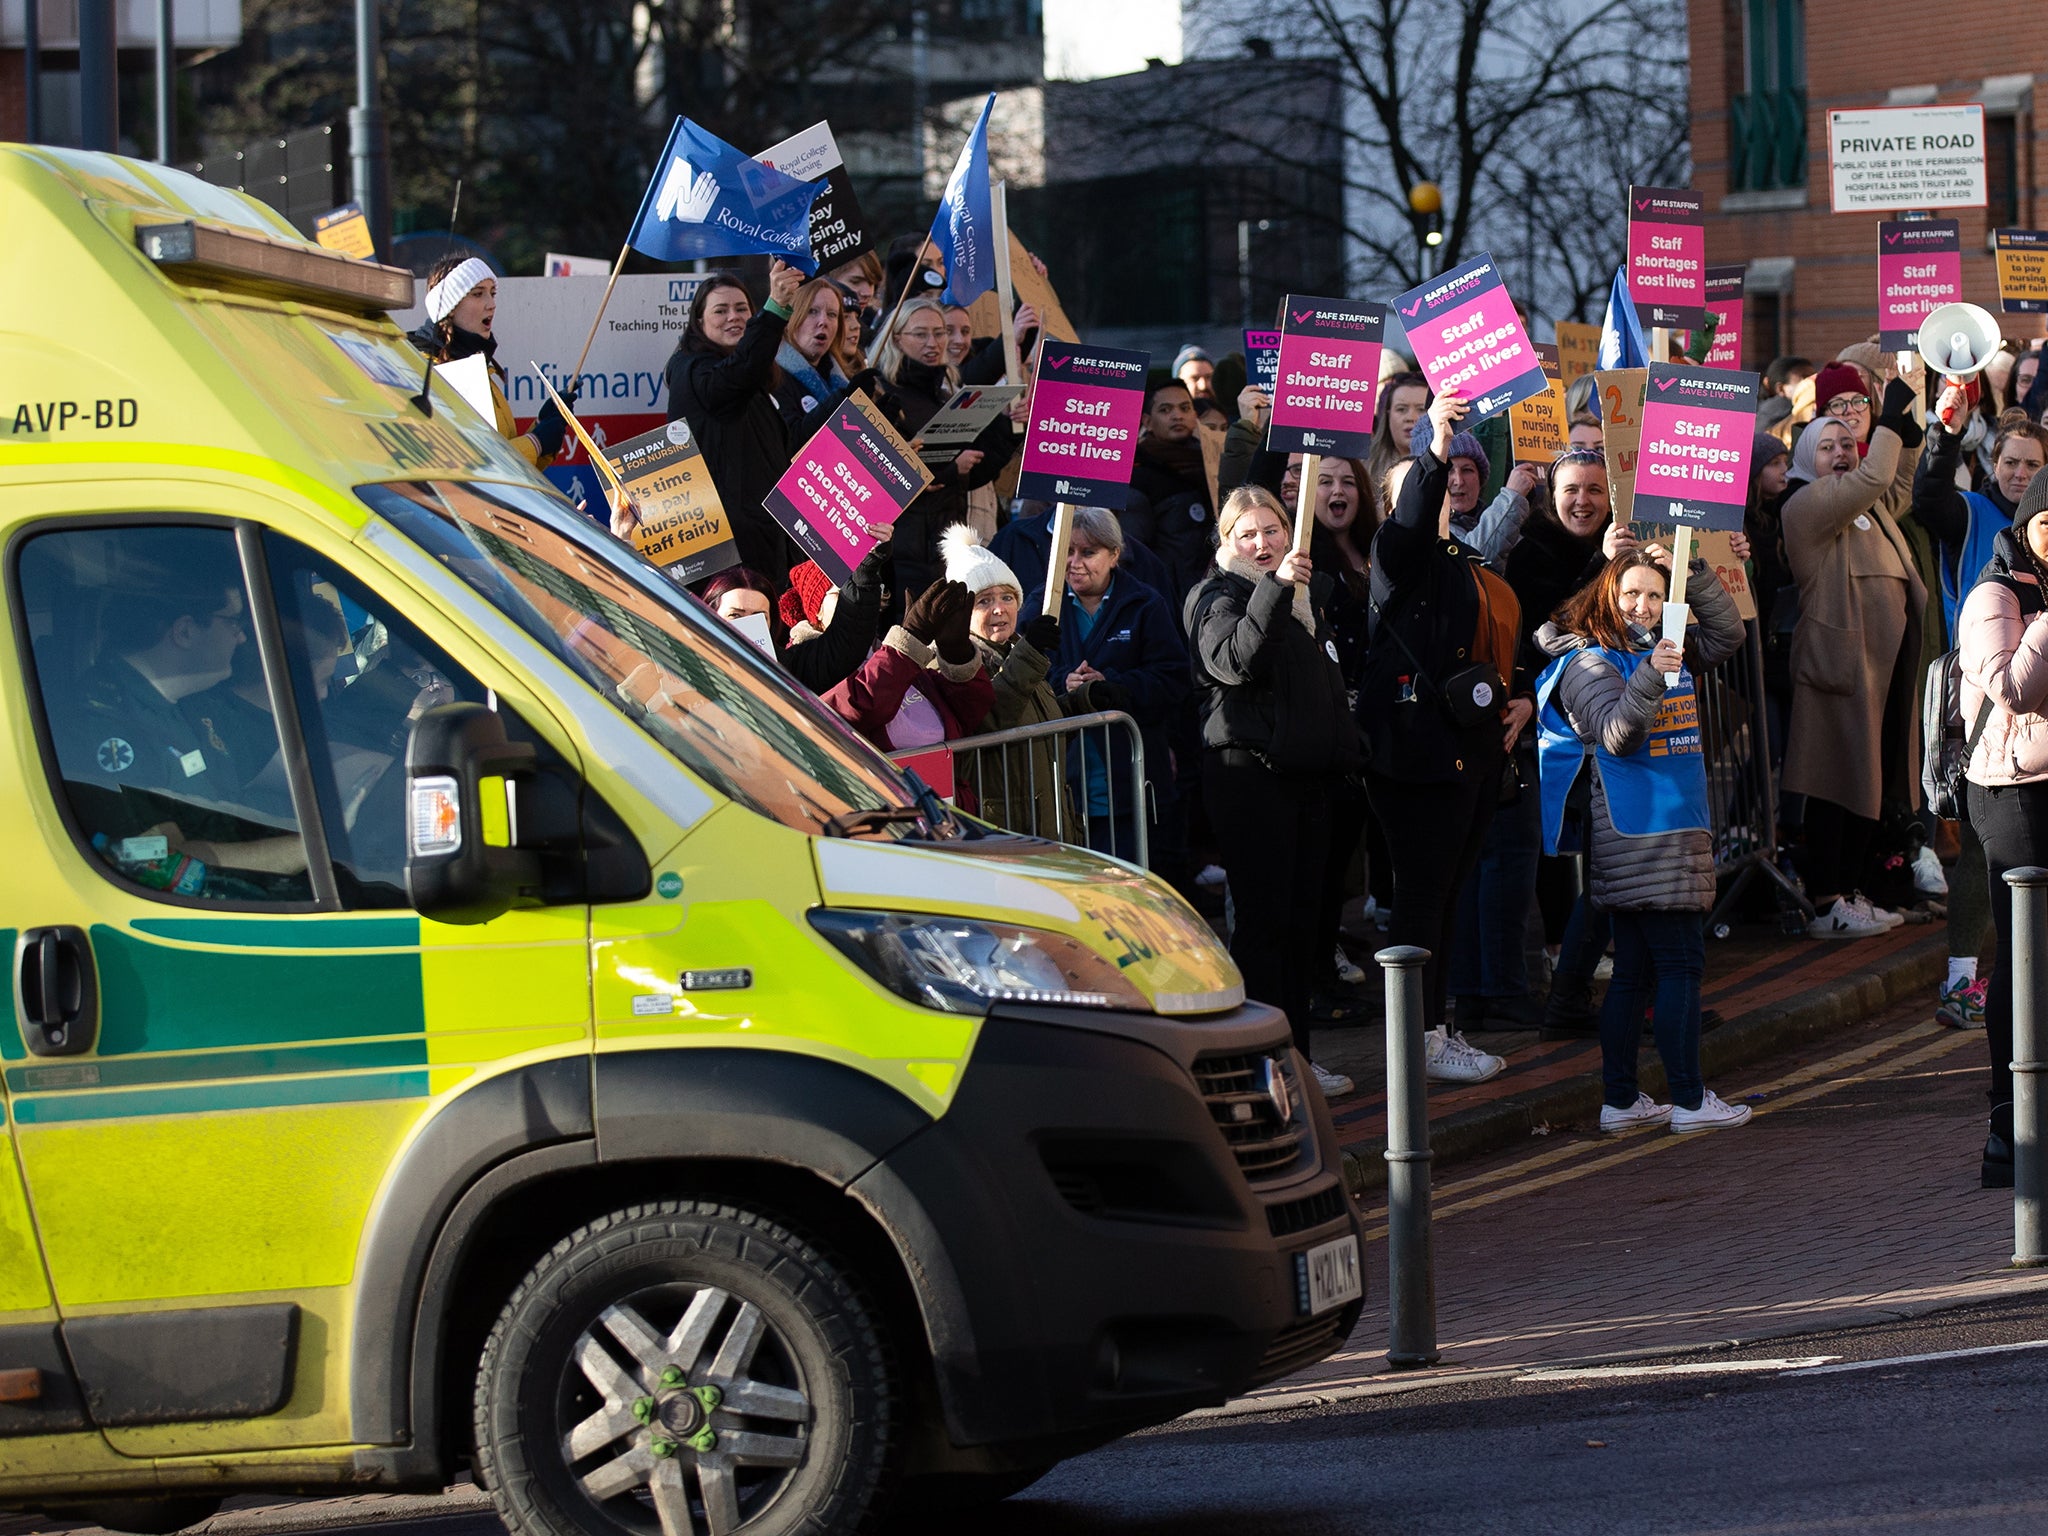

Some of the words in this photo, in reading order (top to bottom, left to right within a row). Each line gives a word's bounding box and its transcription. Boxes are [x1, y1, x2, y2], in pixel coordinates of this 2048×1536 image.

[1840, 136, 1916, 153] PRIVATE
[1923, 134, 1975, 150] ROAD
[779, 155, 800, 172] Royal
[800, 143, 829, 162] College
[1834, 161, 1867, 170] PUBLIC
[1870, 160, 1888, 168] USE
[1905, 158, 1923, 167] THE
[1925, 156, 1984, 166] PERMISSION
[793, 158, 823, 177] Nursing
[1851, 172, 1863, 180] OF
[1866, 171, 1884, 179] THE
[1887, 170, 1917, 179] LEEDS
[1920, 168, 1967, 178] TEACHING
[1845, 182, 1897, 192] HOSPITALS
[1900, 181, 1919, 189] NHS
[1922, 180, 1951, 188] TRUST
[1953, 178, 1974, 187] AND
[1652, 199, 1669, 207] SAFE
[1669, 201, 1699, 210] STAFFING
[1849, 194, 1867, 202] THE
[1869, 191, 1923, 202] UNIVERSITY
[1926, 191, 1938, 199] OF
[1941, 190, 1971, 198] LEEDS
[1652, 206, 1672, 214] SAVES
[760, 228, 804, 251] College
[1921, 230, 1955, 238] STAFFING
[822, 229, 863, 259] fairly
[1651, 236, 1683, 251] Staff
[966, 225, 977, 283] College
[1635, 254, 1698, 272] shortages
[2006, 254, 2021, 262] It's
[2023, 254, 2045, 263] time
[1903, 264, 1937, 278] Staff
[2024, 265, 2042, 273] pay
[1424, 285, 1449, 302] SAFE
[1448, 264, 1491, 291] STAFFING
[1637, 274, 1664, 287] cost
[1666, 274, 1696, 289] lives
[2009, 274, 2046, 283] nursing
[670, 282, 698, 300] NH
[1427, 291, 1456, 309] SAVES
[1458, 278, 1481, 295] LIVES
[1886, 283, 1954, 298] shortages
[2004, 284, 2026, 292] staff
[658, 305, 678, 316] The
[1889, 300, 1919, 314] cost
[609, 320, 659, 333] Teaching
[1315, 319, 1341, 329] SAVES
[1342, 322, 1365, 330] LIVES
[1316, 311, 1337, 320] SAFE
[1339, 314, 1379, 324] STAFFING
[1441, 311, 1485, 344] Staff
[1263, 349, 1274, 357] IF
[1428, 321, 1517, 374] shortages
[1713, 348, 1735, 362] lives
[1073, 357, 1096, 367] SAFE
[1098, 360, 1142, 372] STAFFING
[1309, 352, 1352, 369] Staff
[1440, 363, 1479, 391] cost
[1479, 342, 1522, 371] lives
[1072, 365, 1100, 375] SAVES
[1102, 368, 1126, 378] LIVES
[1286, 371, 1369, 394] shortages
[1680, 379, 1704, 389] SAFE
[1705, 382, 1750, 394] STAFFING
[1679, 387, 1708, 397] SAVES
[1710, 390, 1736, 400] LIVES
[1065, 398, 1111, 417] Staff
[1286, 394, 1322, 409] cost
[1325, 395, 1363, 412] lives
[1523, 401, 1534, 413] to
[1537, 405, 1553, 418] pay
[13, 398, 138, 434] AVP-BD
[1039, 417, 1129, 442] shortages
[1522, 418, 1559, 436] nursing
[1674, 420, 1721, 439] Staff
[1038, 440, 1077, 456] cost
[1080, 443, 1122, 462] lives
[1518, 436, 1541, 448] staff
[1648, 439, 1741, 463] shortages
[623, 449, 646, 463] FAIR
[646, 440, 665, 454] PAY
[626, 458, 647, 471] FOR
[648, 444, 691, 463] NURSING
[855, 438, 878, 464] SAVES
[877, 462, 897, 485] LIVES
[859, 432, 880, 454] SAFE
[878, 453, 912, 491] STAFFING
[653, 471, 692, 493] time
[833, 462, 872, 502] Staff
[1649, 464, 1689, 479] cost
[1692, 464, 1735, 484] lives
[661, 491, 692, 511] pay
[805, 460, 872, 534] shortages
[797, 477, 829, 511] cost
[826, 506, 860, 547] lives
[641, 506, 705, 539] nursing
[677, 518, 720, 543] fairly
[1659, 702, 1679, 715] THE
[1653, 717, 1668, 728] OF
[1669, 736, 1690, 746] FAIR
[1672, 746, 1688, 755] FOR
